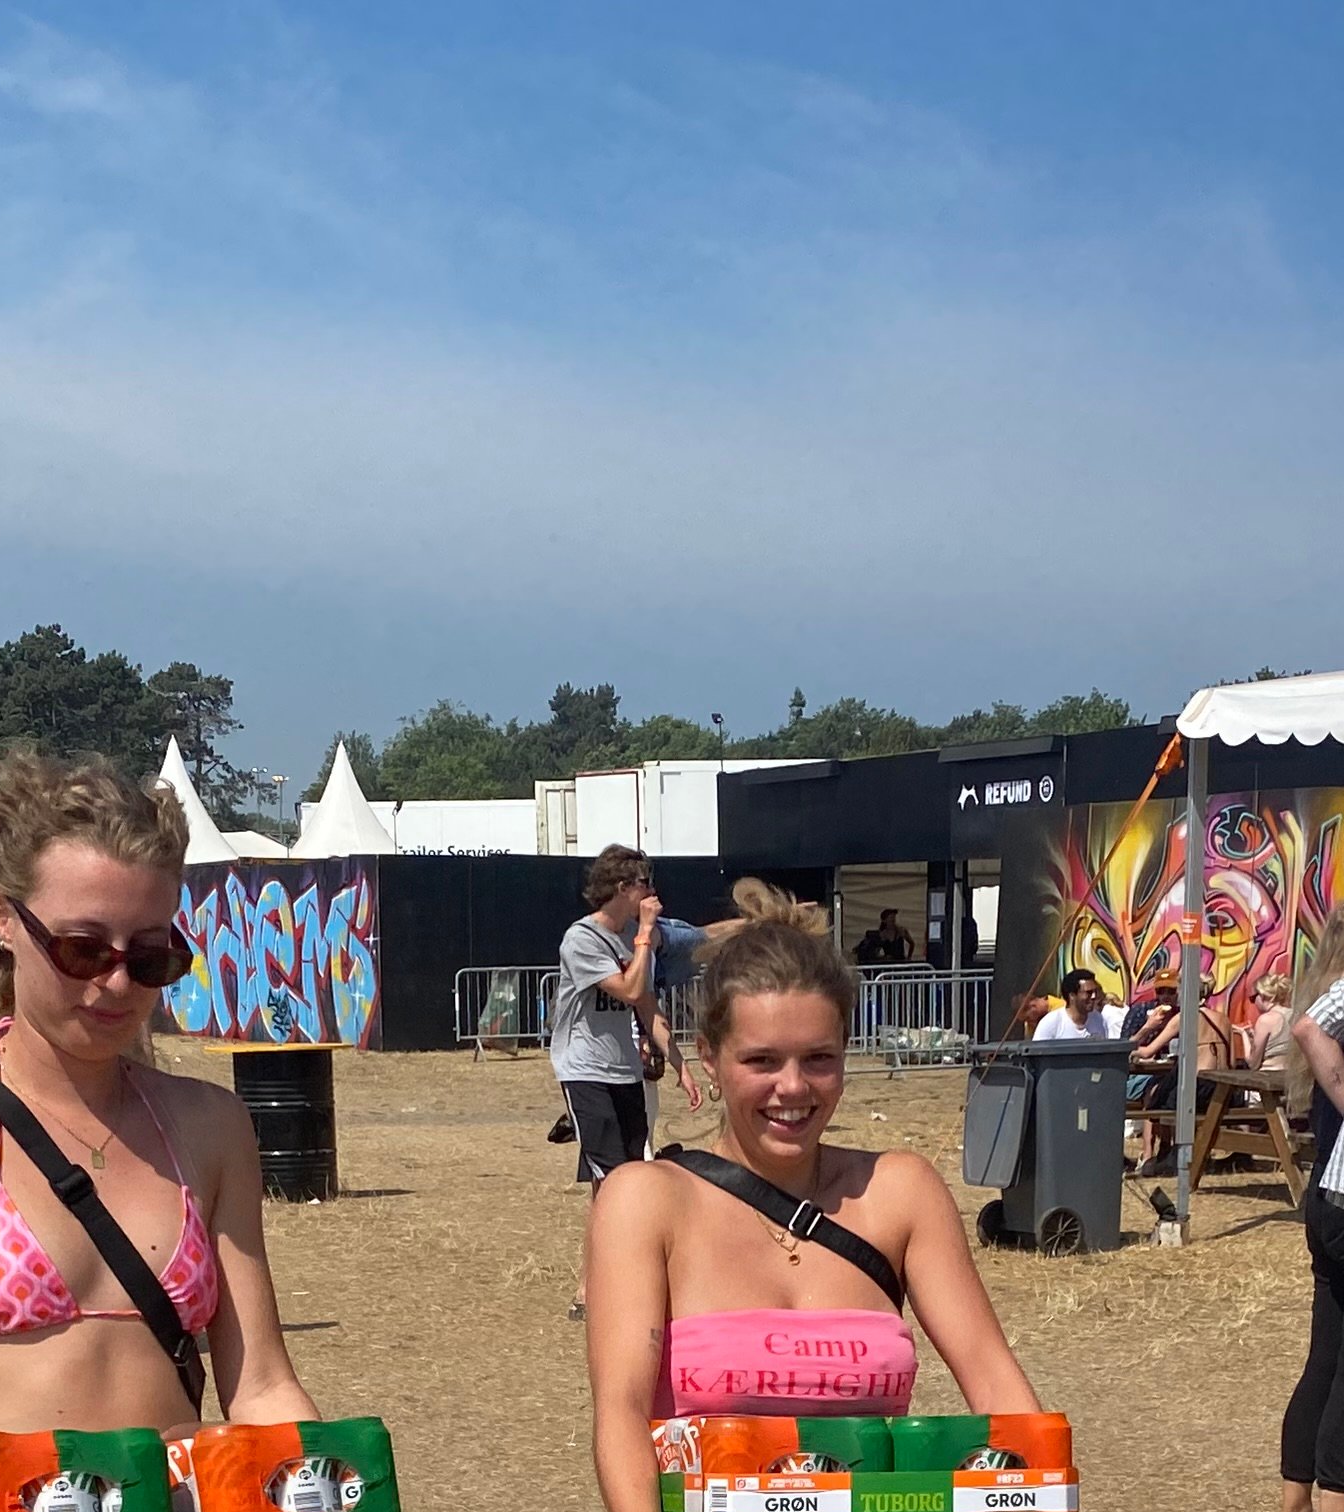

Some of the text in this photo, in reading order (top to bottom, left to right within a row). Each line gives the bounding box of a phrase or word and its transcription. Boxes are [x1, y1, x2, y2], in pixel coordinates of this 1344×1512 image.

[984, 780, 1032, 806] REFUND
[764, 1332, 868, 1364] Camp
[765, 1496, 818, 1512] GRØN
[985, 1492, 1036, 1509] GRØN
